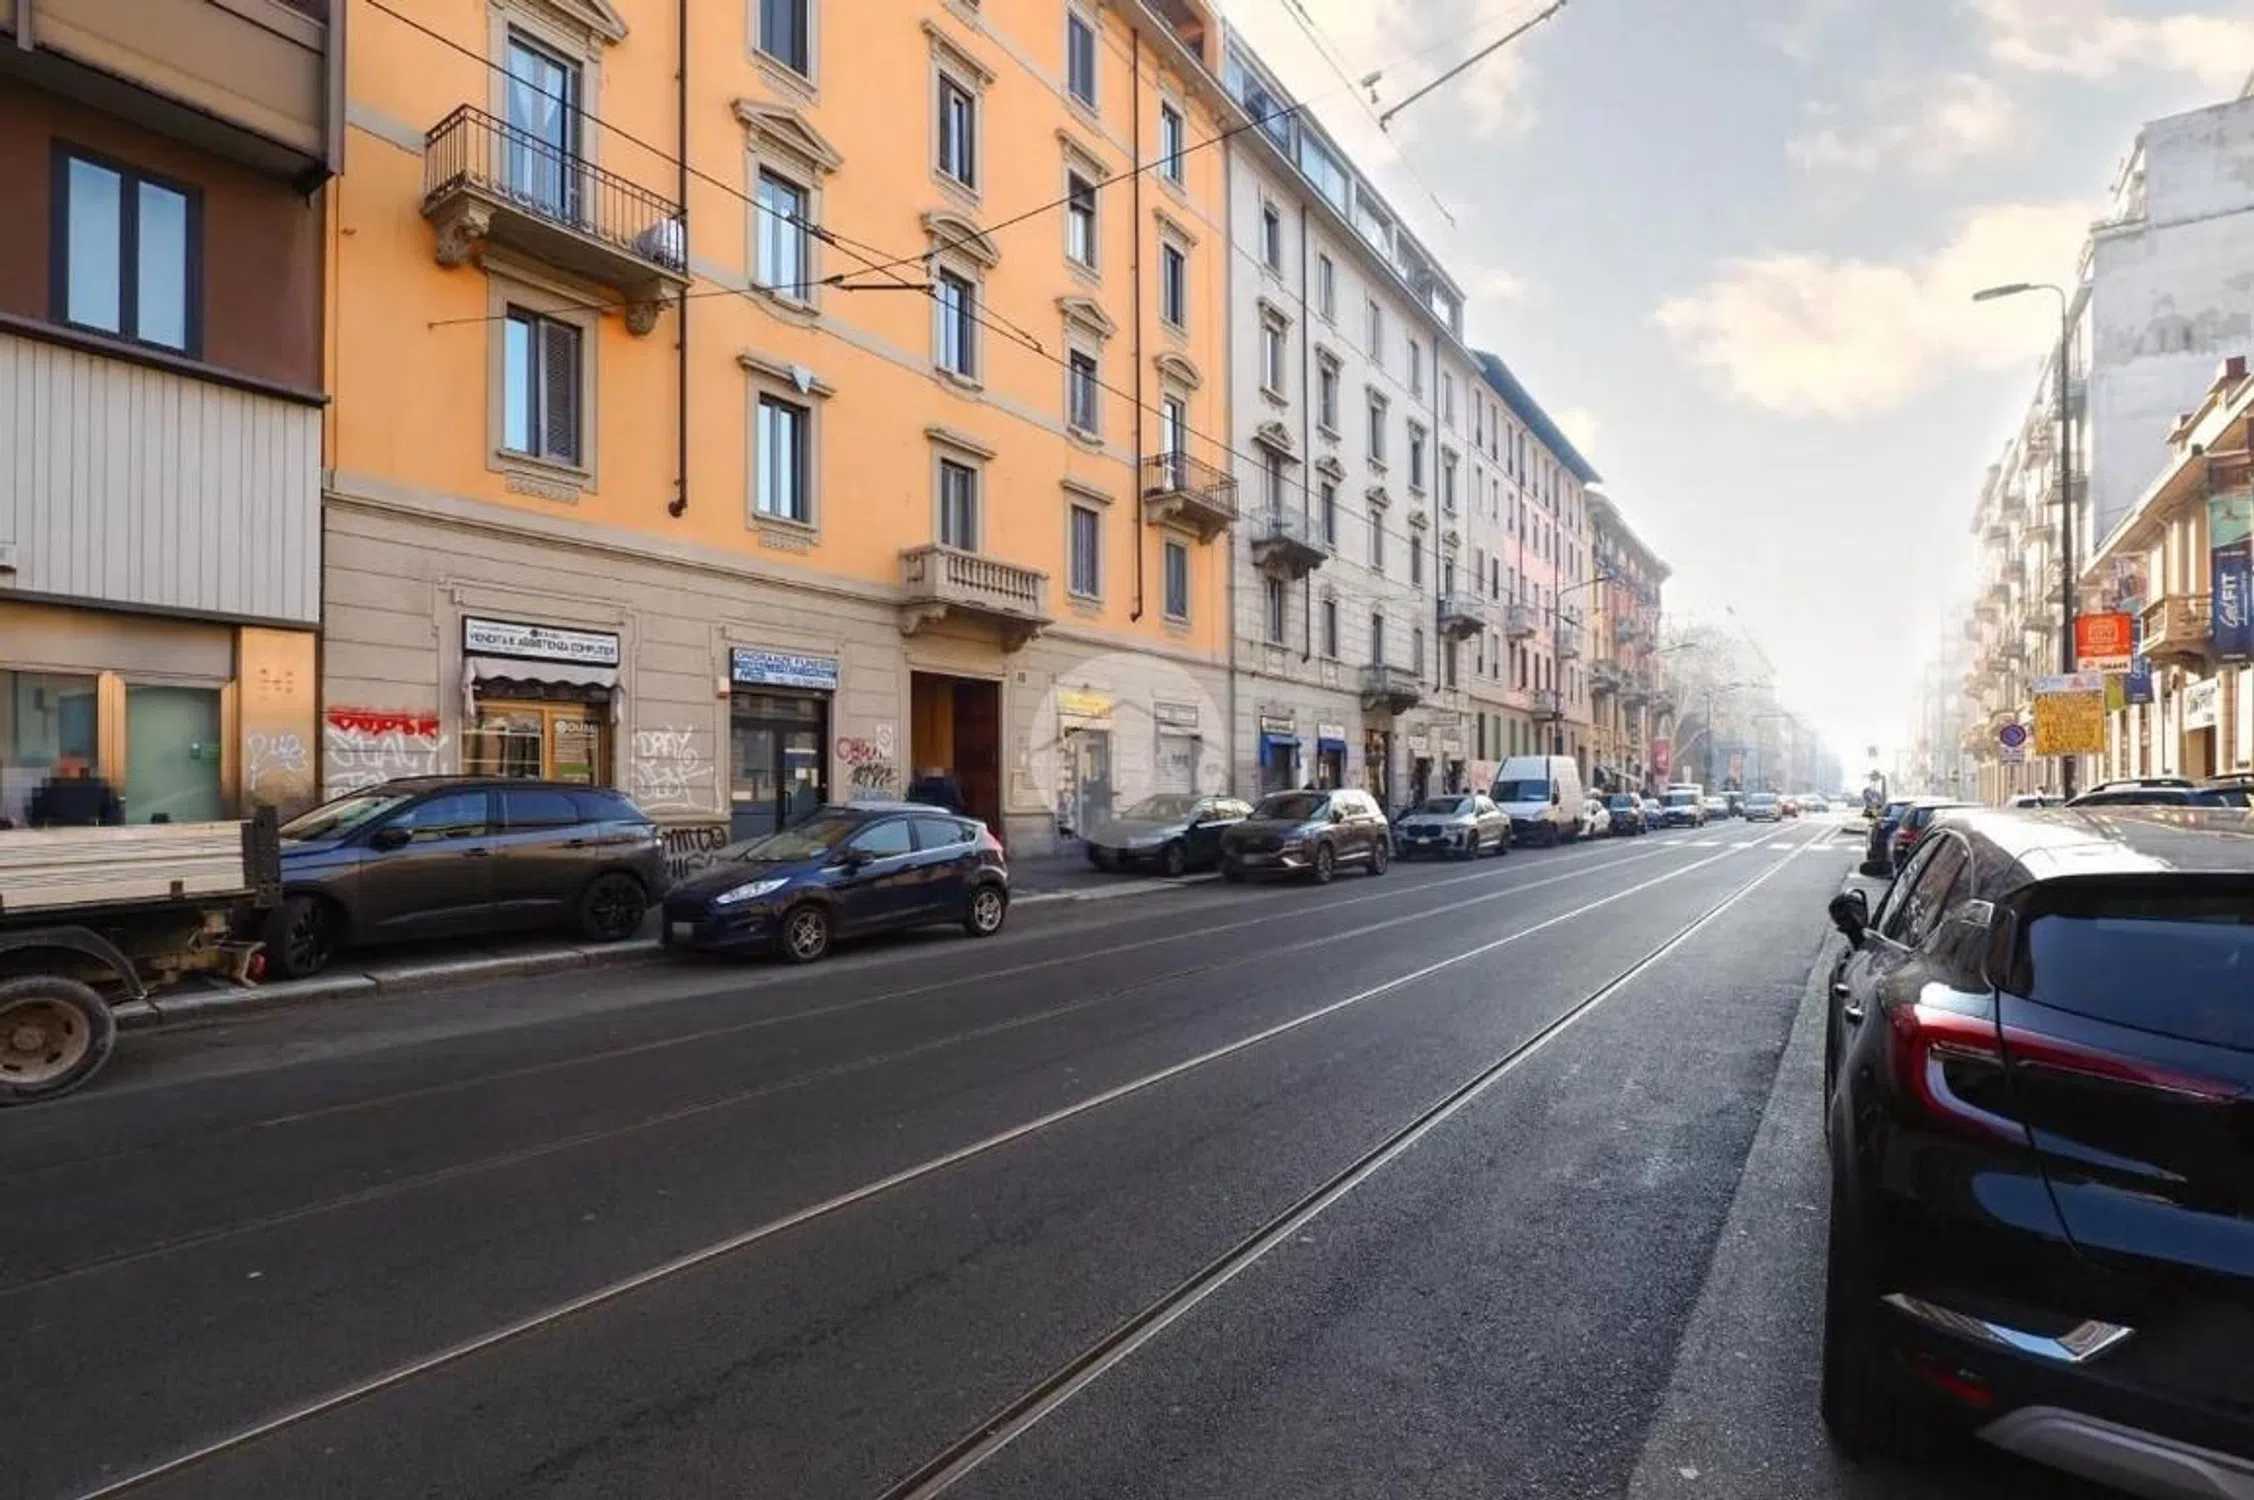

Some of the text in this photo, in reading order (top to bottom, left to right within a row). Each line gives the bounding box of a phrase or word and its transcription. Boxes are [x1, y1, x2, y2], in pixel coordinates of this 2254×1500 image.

[469, 632, 508, 646] VENDITA
[518, 638, 568, 652] ASSISTENZA
[570, 643, 615, 656] COMPUTER
